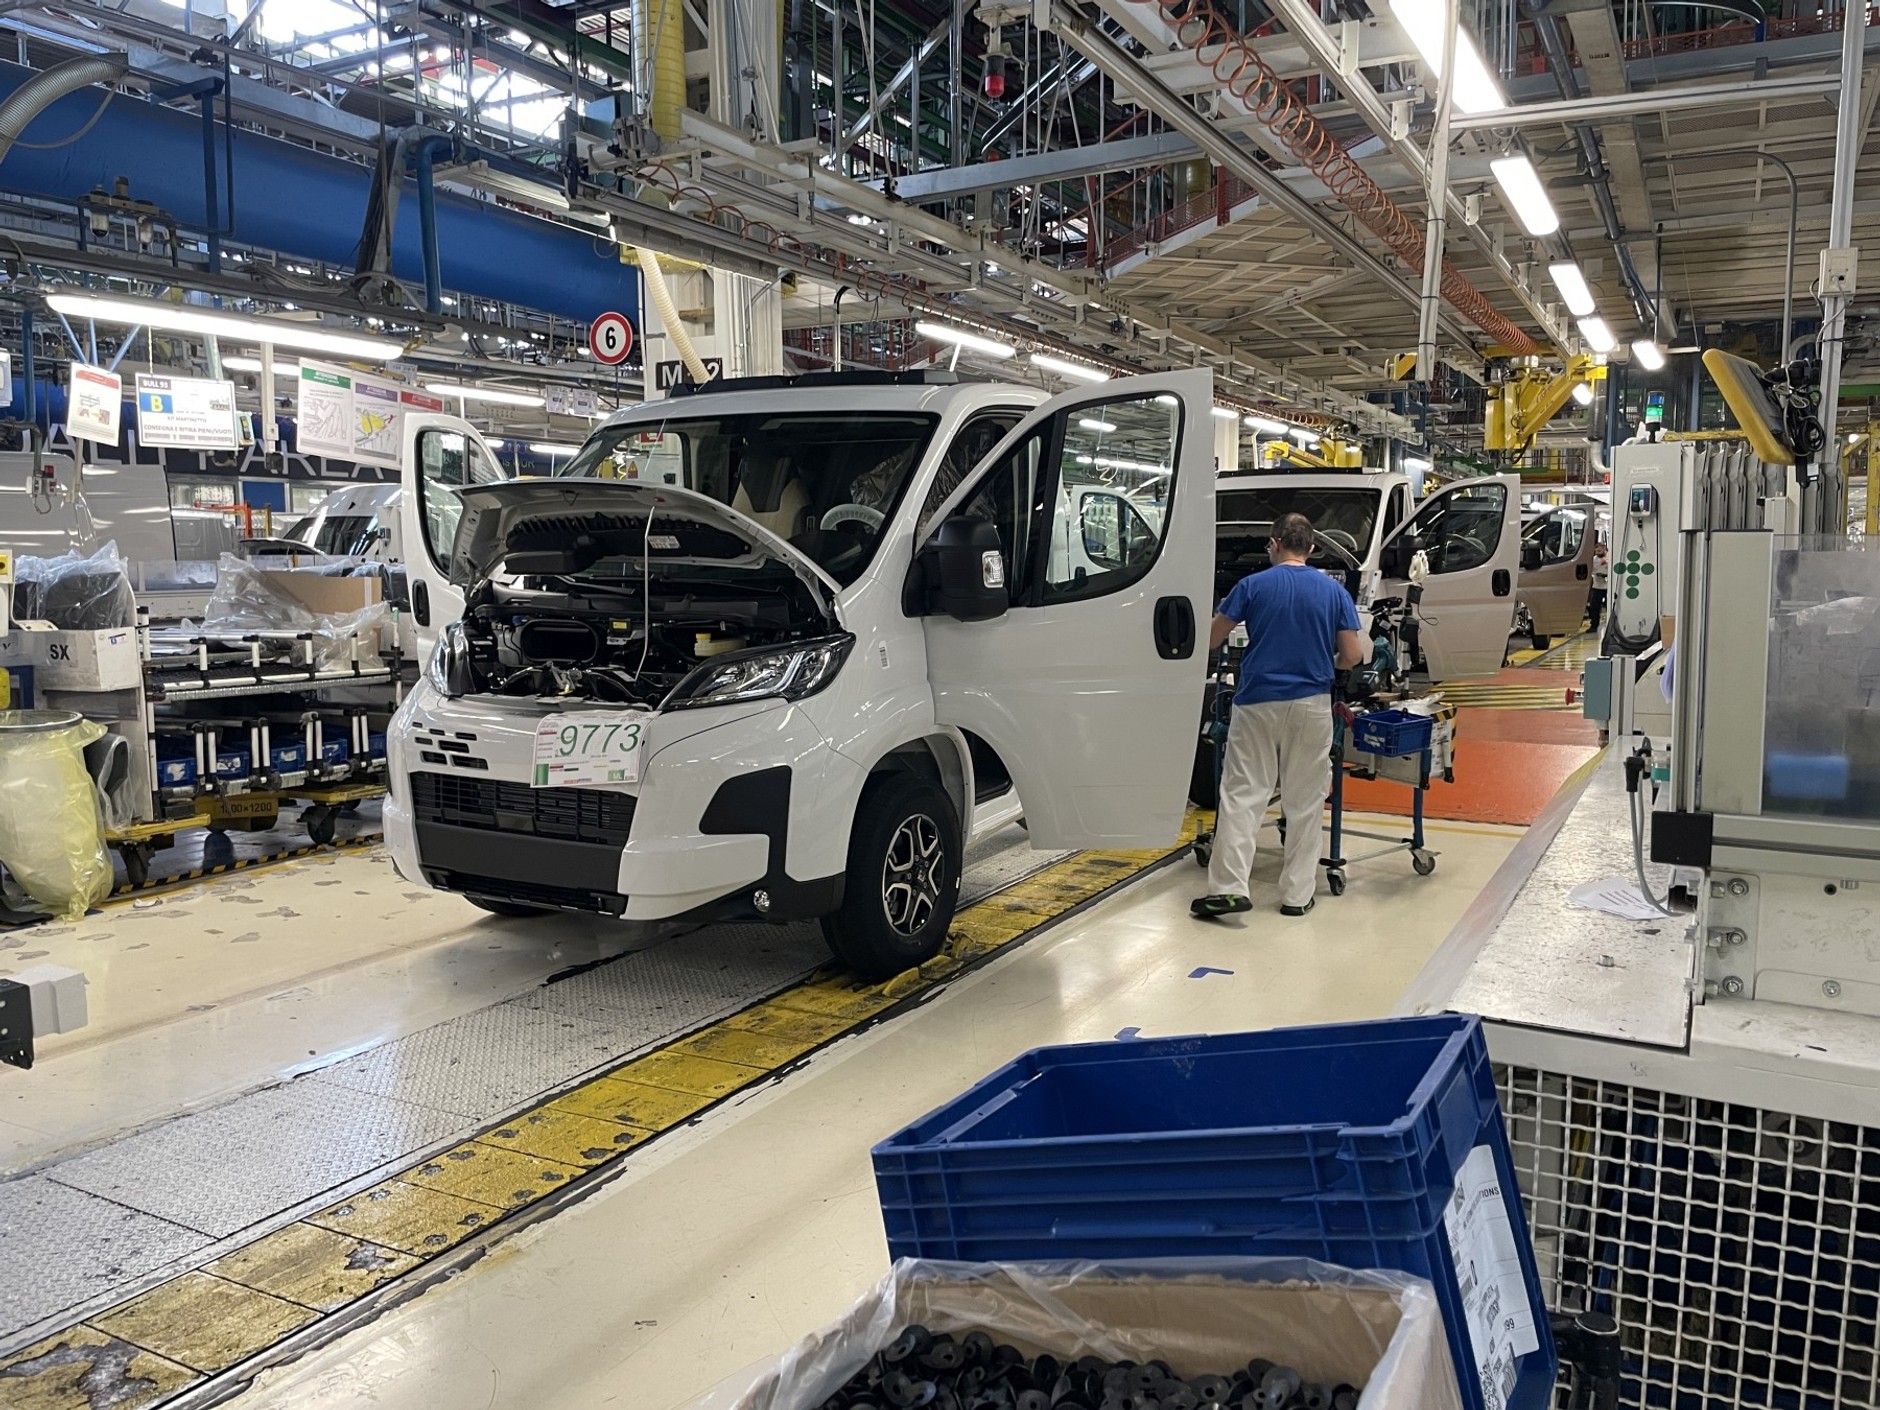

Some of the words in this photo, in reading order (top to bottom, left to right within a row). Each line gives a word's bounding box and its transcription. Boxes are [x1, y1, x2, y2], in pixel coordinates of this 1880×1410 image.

[605, 326, 617, 350] 6
[150, 395, 164, 412] B
[144, 424, 174, 432] CONSEGNA
[49, 643, 70, 661] SX
[559, 723, 642, 756] 9773
